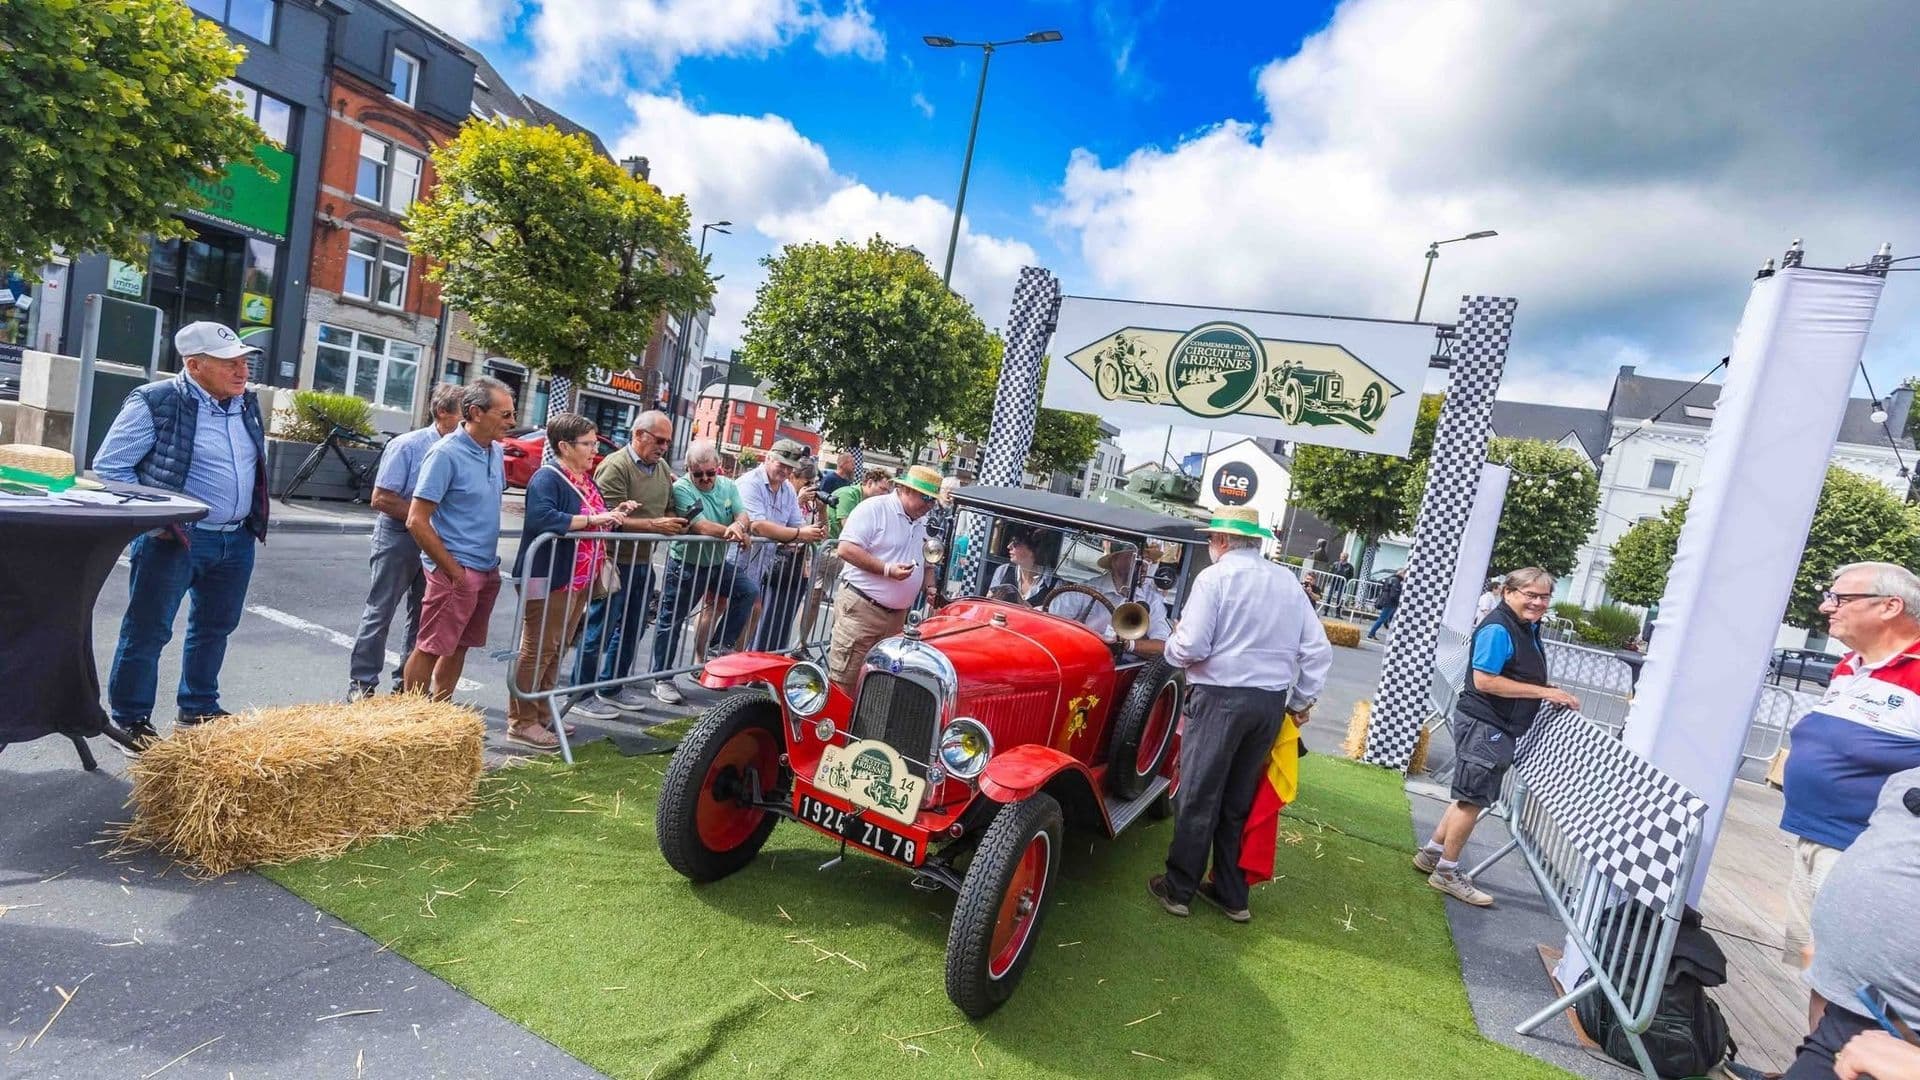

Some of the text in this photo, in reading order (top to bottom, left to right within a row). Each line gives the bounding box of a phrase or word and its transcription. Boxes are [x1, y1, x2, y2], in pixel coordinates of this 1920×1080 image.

[1185, 346, 1252, 360] CIRCUIT DES
[1190, 340, 1251, 351] COMMEMORATION
[1180, 354, 1252, 371] ARDENNES
[612, 375, 643, 393] IMMO
[1220, 469, 1250, 488] ice
[1219, 486, 1248, 497] watch
[899, 777, 915, 793] 14
[802, 796, 915, 863] 1924 ZL 78
